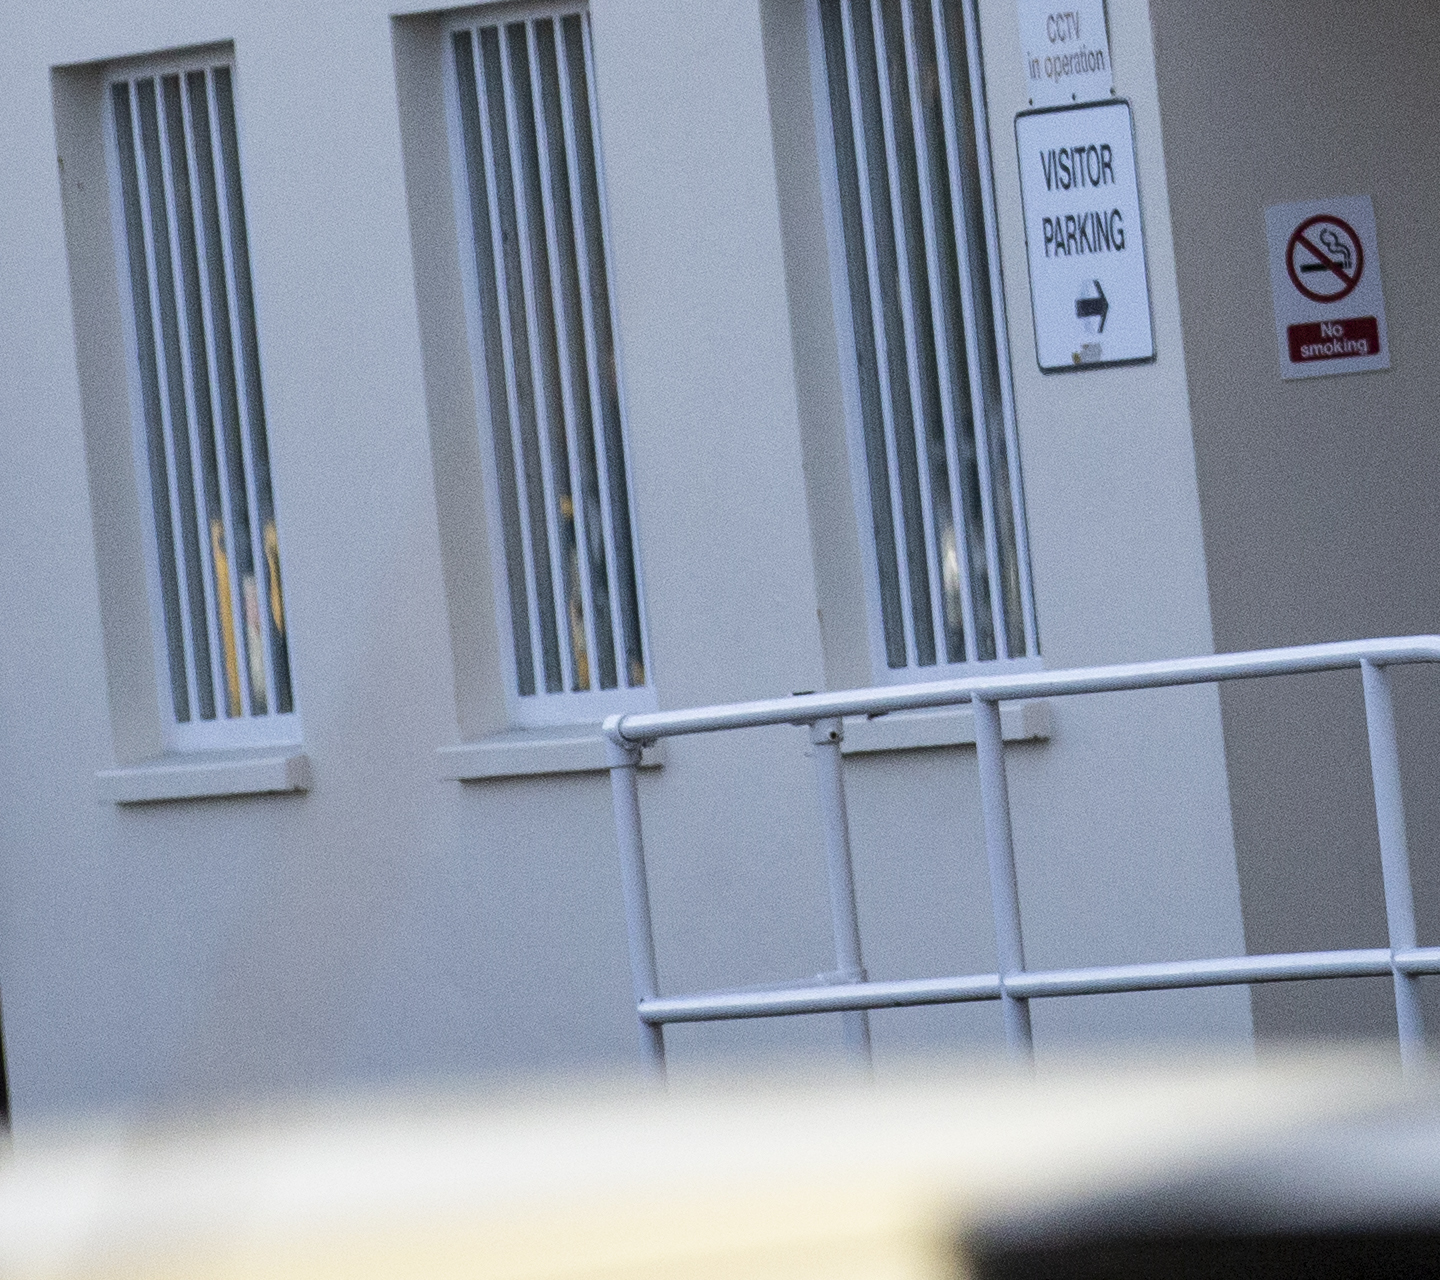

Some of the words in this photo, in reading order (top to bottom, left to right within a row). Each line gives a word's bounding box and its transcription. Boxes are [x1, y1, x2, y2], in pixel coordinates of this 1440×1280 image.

[1046, 11, 1080, 43] CCTV
[1027, 51, 1041, 79] in
[1044, 44, 1105, 83] operation
[1040, 143, 1116, 191] VISITOR
[1042, 208, 1126, 258] PARKING
[1320, 321, 1344, 338] No
[1300, 338, 1368, 358] smoking
